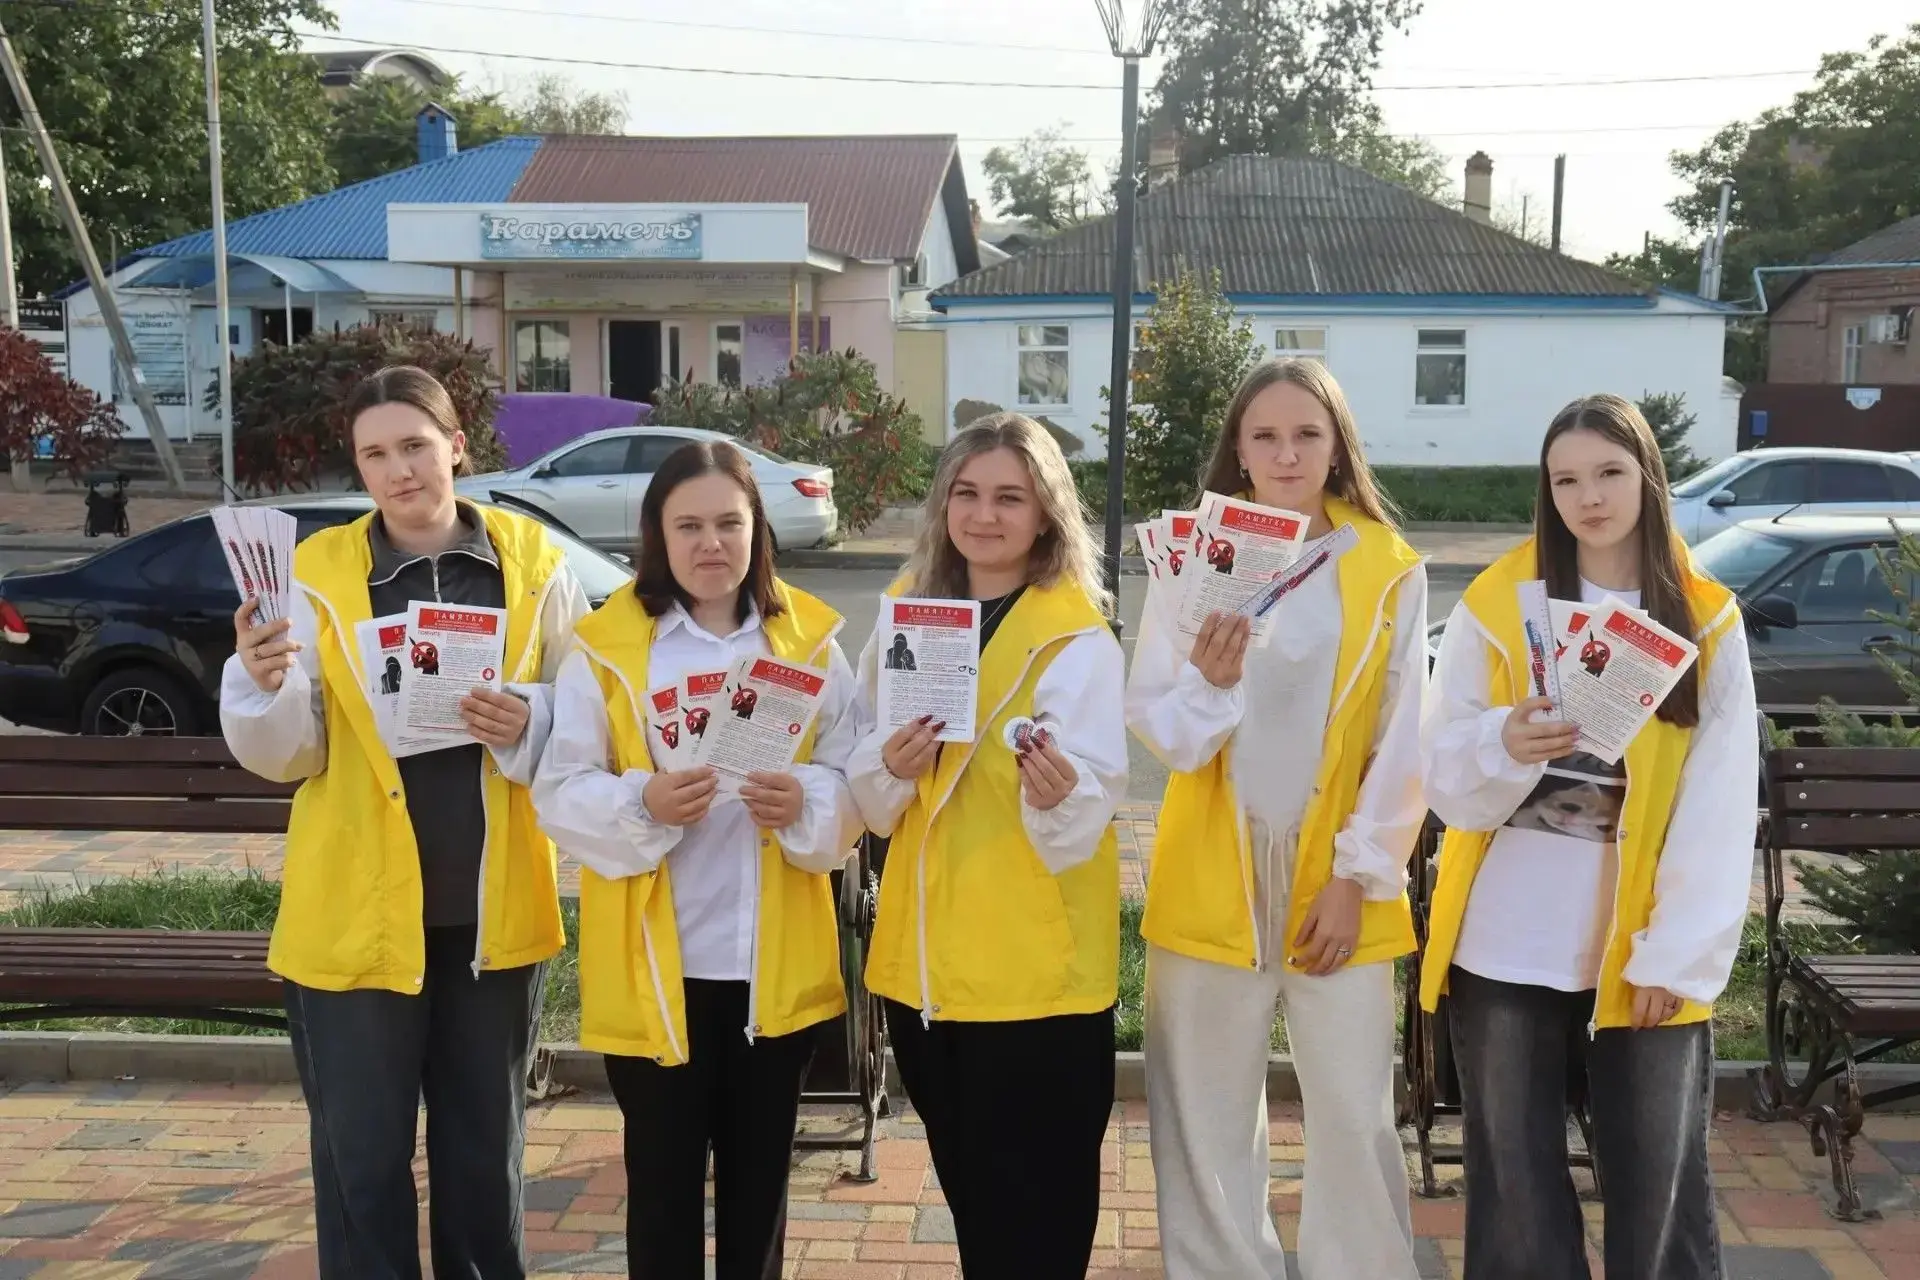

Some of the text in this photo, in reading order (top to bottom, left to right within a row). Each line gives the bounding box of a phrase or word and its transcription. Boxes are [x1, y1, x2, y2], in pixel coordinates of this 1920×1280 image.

[487, 216, 693, 245] Карамель
[1237, 510, 1286, 528] ПАМЯТКА
[433, 611, 484, 623] ПАМЯТКА
[908, 606, 959, 616] ПАМЯТКА
[1624, 620, 1672, 651] ПАМЯТКА
[766, 663, 811, 683] ПАМЯТКА
